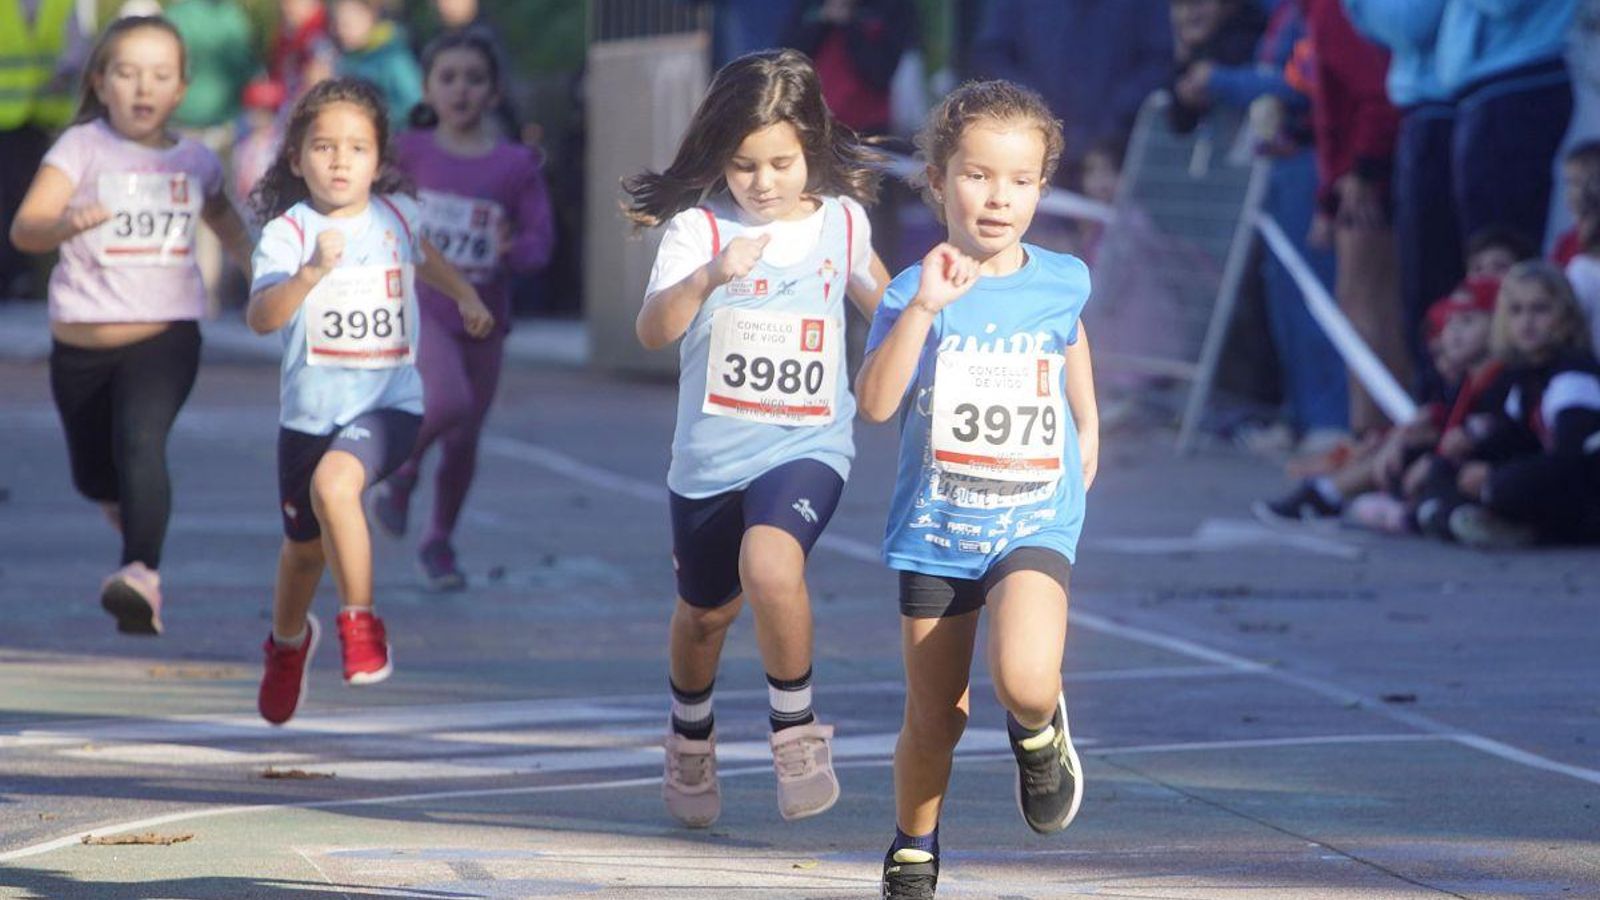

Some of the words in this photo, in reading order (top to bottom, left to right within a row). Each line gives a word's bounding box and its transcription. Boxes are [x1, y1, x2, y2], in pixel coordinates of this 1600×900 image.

[115, 211, 191, 238] 3977
[323, 305, 405, 339] 3981
[737, 321, 793, 333] CONCELLO
[743, 332, 755, 341] DE
[761, 334, 786, 344] VIGO
[722, 353, 824, 395] 3980
[967, 365, 1029, 377] CONCELLO
[975, 377, 992, 388] DE
[952, 403, 1056, 445] 3979
